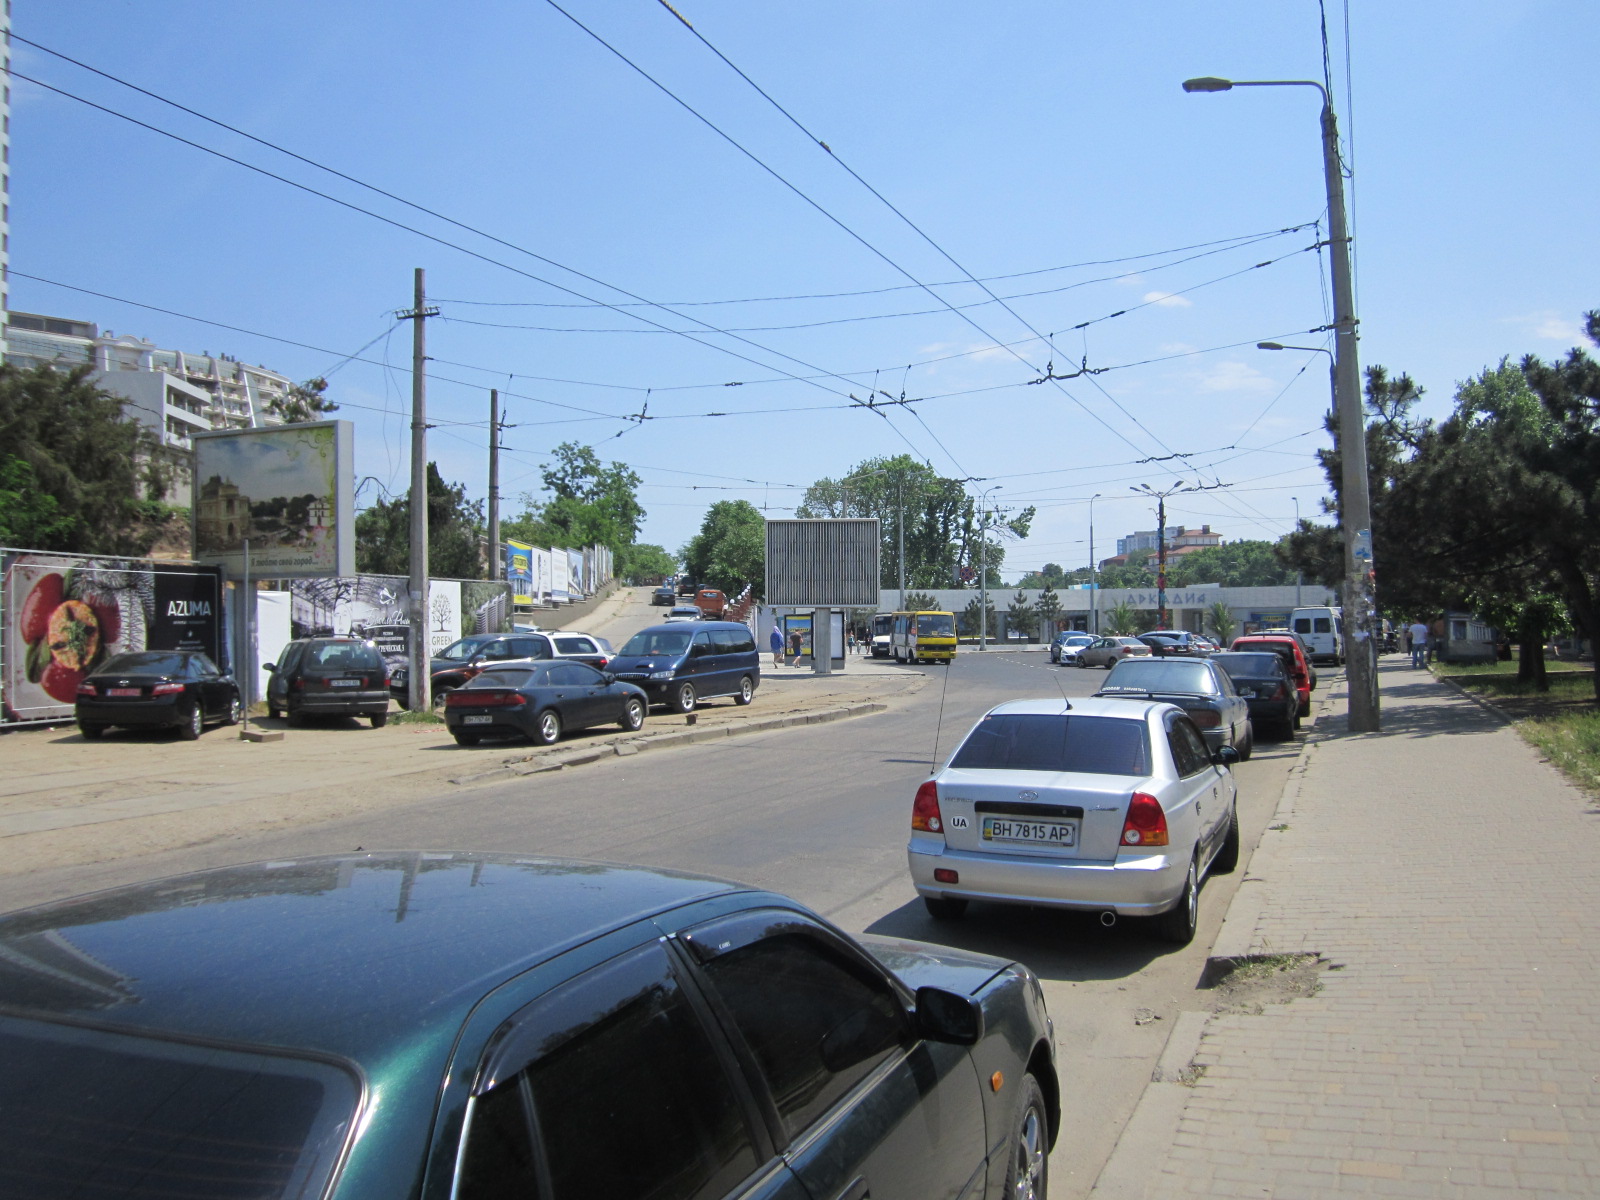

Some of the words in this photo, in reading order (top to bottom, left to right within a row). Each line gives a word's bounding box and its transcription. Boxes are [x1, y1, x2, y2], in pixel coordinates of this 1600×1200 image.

[255, 558, 277, 567] люблю
[278, 557, 293, 566] свой
[167, 600, 212, 617] AZUMA
[431, 636, 452, 646] GREEN
[952, 817, 967, 828] UA
[992, 822, 1012, 837] BH
[1015, 823, 1046, 839] 7815
[1049, 826, 1070, 841] AP
